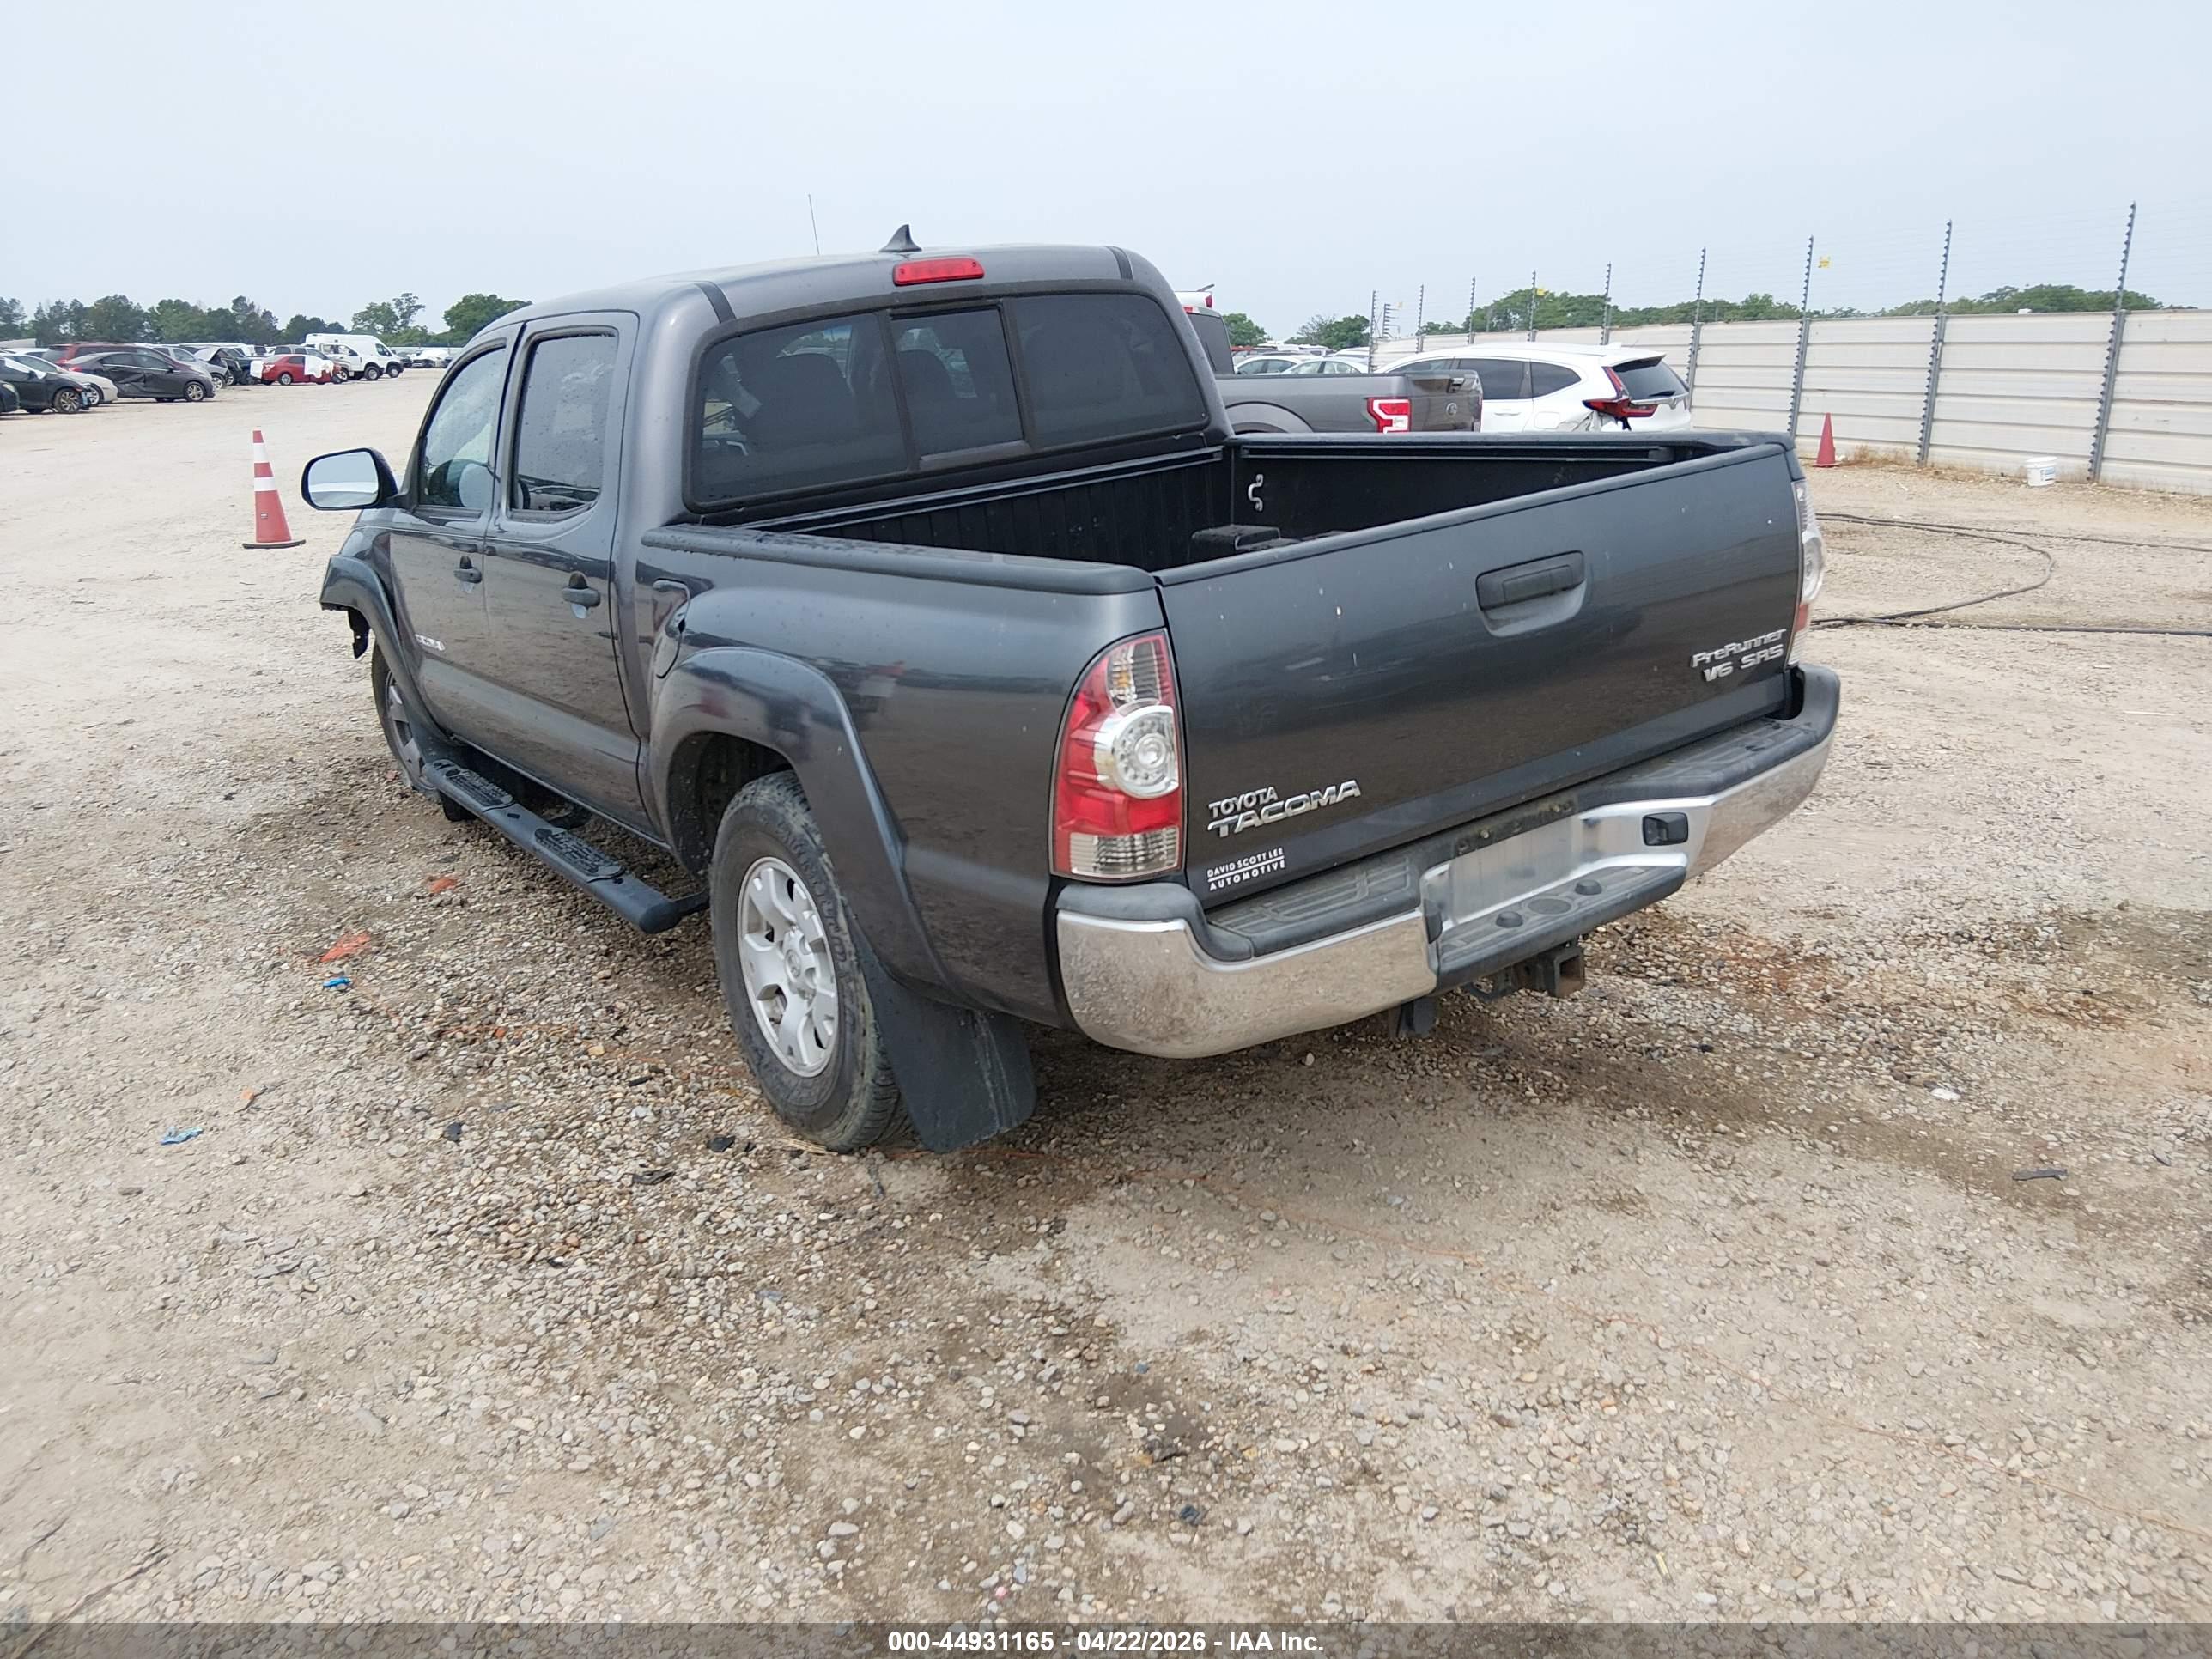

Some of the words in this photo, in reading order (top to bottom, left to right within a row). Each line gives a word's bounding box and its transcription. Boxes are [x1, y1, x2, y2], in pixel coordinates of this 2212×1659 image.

[1692, 629, 1787, 668] PreRunner
[1703, 661, 1734, 682] V6
[1740, 644, 1784, 669] SR5
[1206, 779, 1362, 837] TACOMA
[1208, 786, 1279, 818] TOYOTA
[1206, 862, 1236, 878] DAVID
[1237, 853, 1267, 868] SCOTT
[1268, 847, 1284, 859] LEE
[1209, 860, 1286, 891] AUTOMOTIVE
